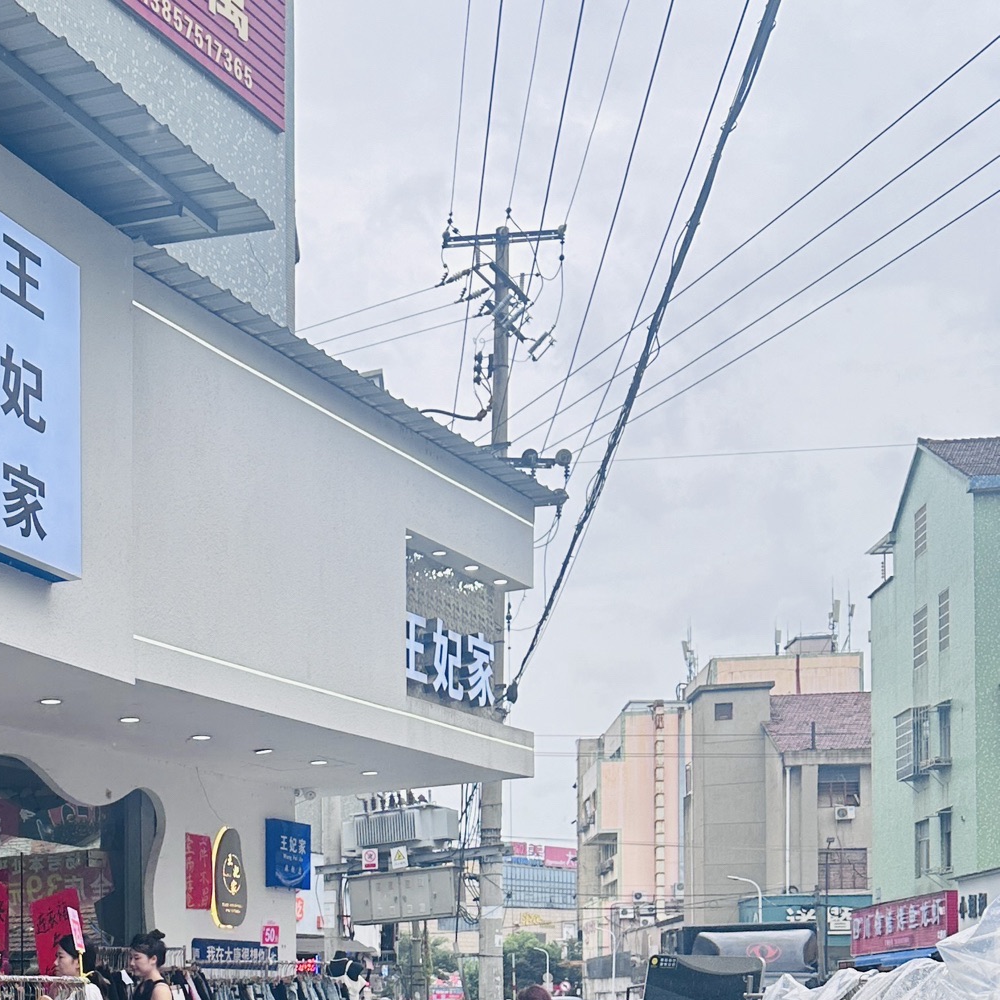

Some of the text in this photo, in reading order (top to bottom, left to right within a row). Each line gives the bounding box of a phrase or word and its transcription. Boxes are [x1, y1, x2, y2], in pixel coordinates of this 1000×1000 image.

[144, 0, 253, 89] 3857517365
[0, 232, 47, 541] 王妃家
[406, 611, 496, 707] 王妃家
[279, 834, 307, 856] 王妃家
